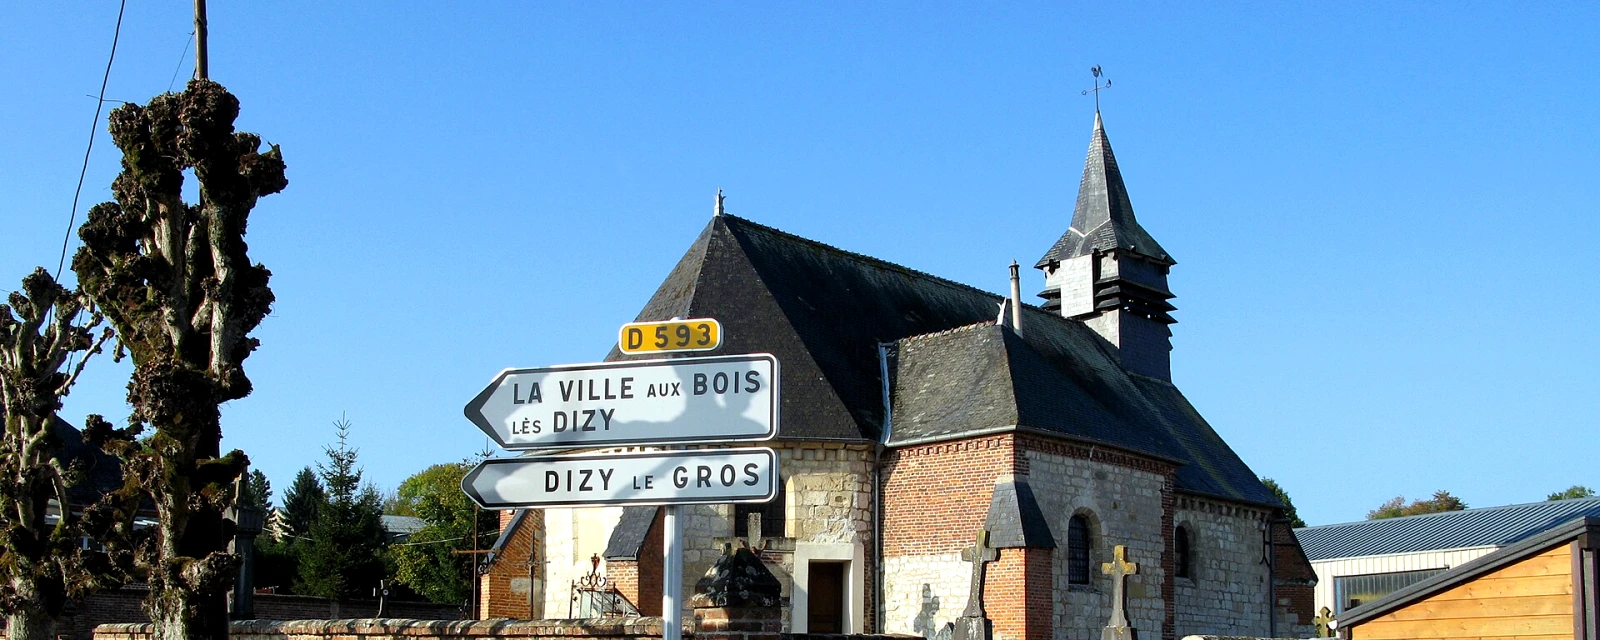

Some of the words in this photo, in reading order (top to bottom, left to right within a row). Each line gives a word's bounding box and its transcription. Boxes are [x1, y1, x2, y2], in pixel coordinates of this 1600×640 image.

[628, 328, 644, 350] D
[655, 323, 711, 348] 593
[513, 382, 543, 405] LA
[559, 377, 634, 402] VILLE
[647, 382, 681, 398] AUX
[693, 370, 761, 396] BOIS
[512, 418, 541, 435] LÈS
[553, 408, 616, 433] DIZY
[545, 468, 614, 493] DIZY
[633, 475, 654, 490] LE
[673, 463, 760, 489] GROS
